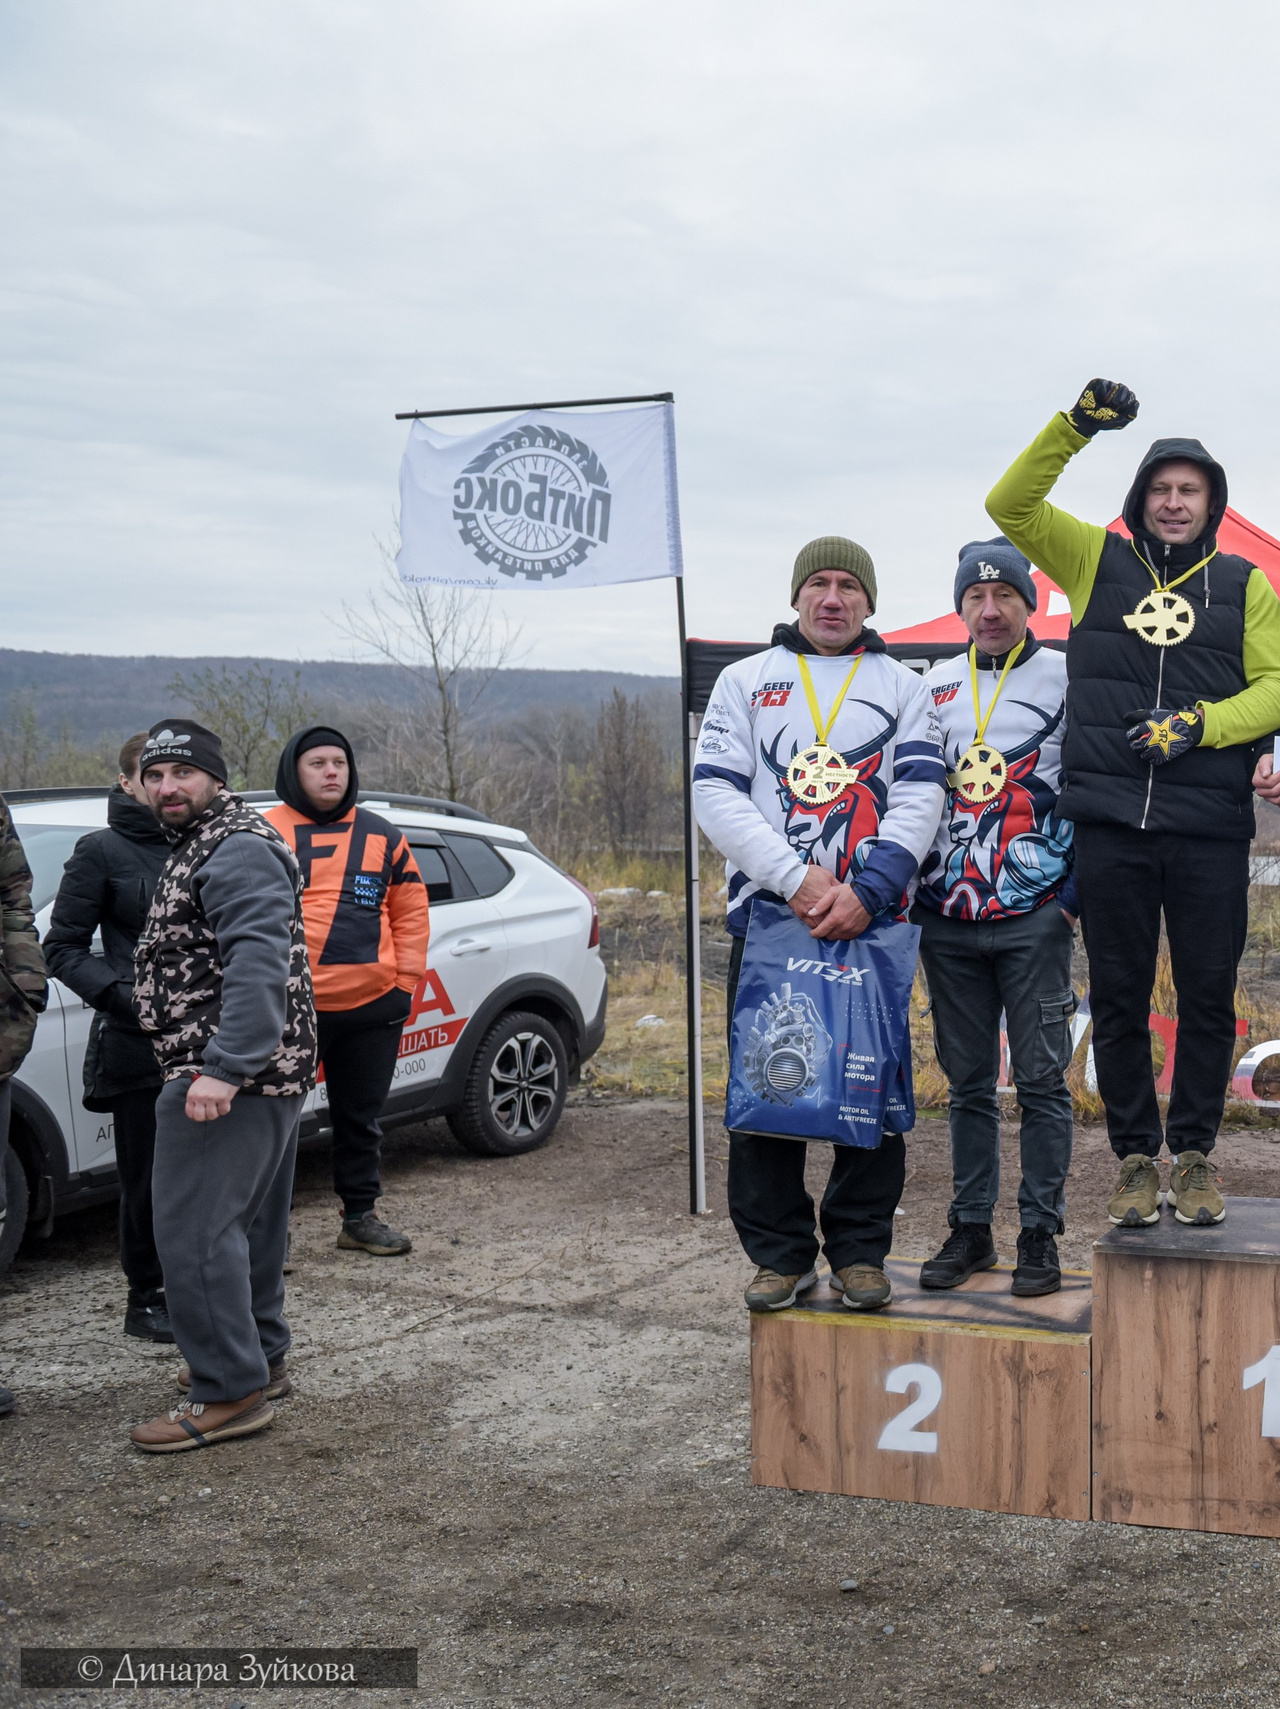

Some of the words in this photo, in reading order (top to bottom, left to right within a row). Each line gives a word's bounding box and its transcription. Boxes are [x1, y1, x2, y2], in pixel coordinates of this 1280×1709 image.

[142, 747, 192, 761] adidas
[812, 766, 825, 779] 2
[847, 1052, 875, 1063] Живая
[845, 1063, 866, 1071] сила
[844, 1072, 875, 1081] мотора
[839, 1105, 860, 1114] MOTOR
[843, 1114, 878, 1125] ANTIFREEZE
[877, 1362, 943, 1454] 2
